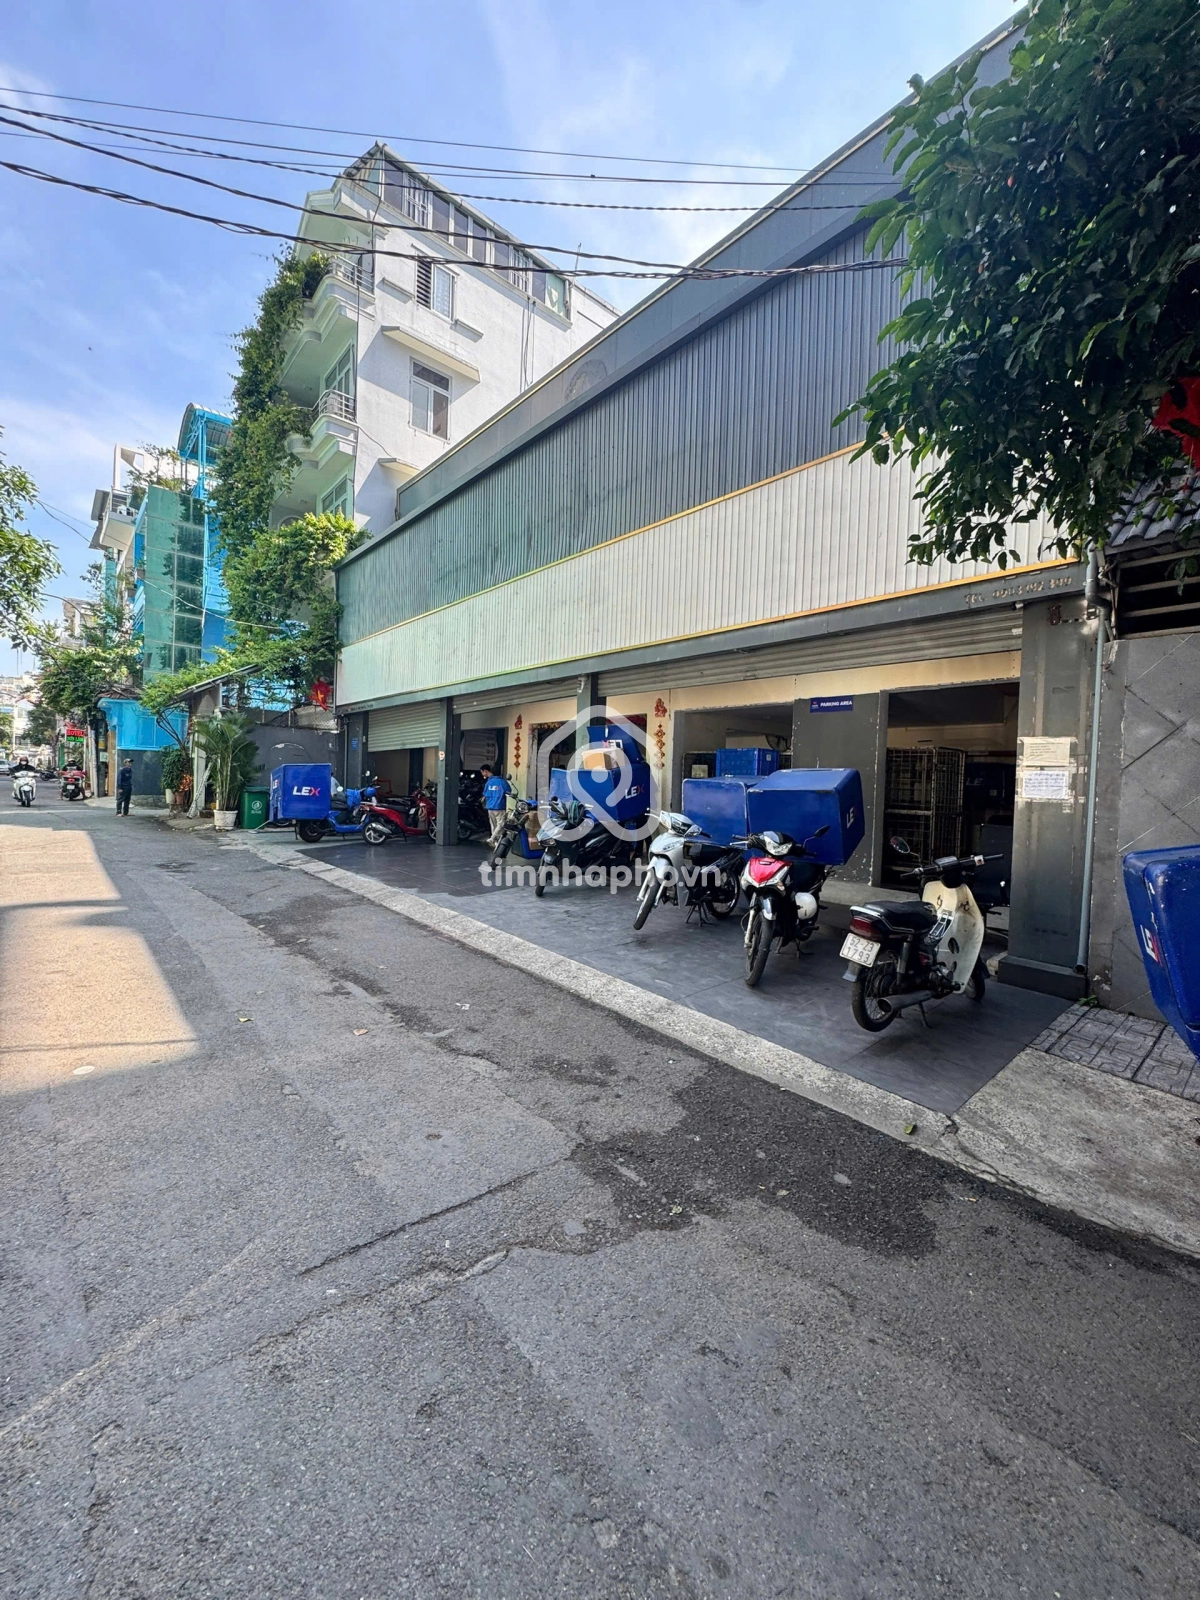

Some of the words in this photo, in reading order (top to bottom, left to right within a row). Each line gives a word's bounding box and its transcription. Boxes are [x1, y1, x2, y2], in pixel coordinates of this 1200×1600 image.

[292, 786, 320, 796] LEX
[625, 784, 644, 799] LEX
[846, 946, 871, 963] 1793
